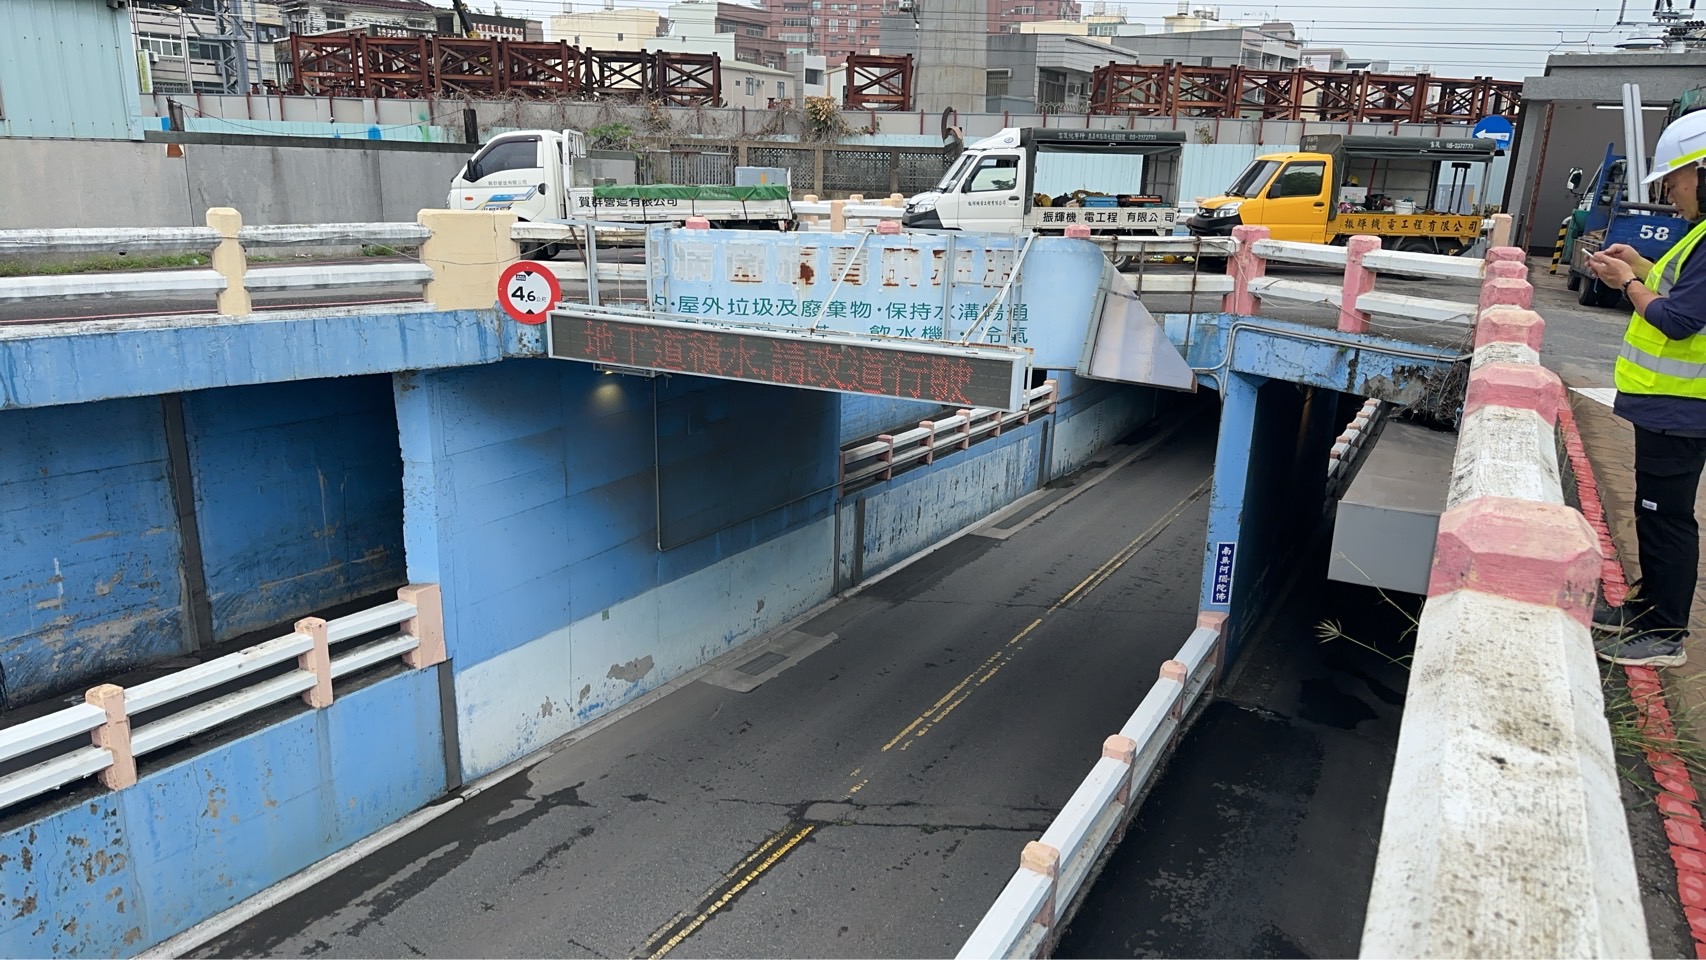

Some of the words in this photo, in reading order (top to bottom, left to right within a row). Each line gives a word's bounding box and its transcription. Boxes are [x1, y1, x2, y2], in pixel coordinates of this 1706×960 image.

[578, 196, 678, 208] 賀群營造有限公司
[1344, 218, 1479, 232] 振輝機電工程有限公司
[1639, 224, 1670, 241] 58
[511, 286, 536, 303] 4.6
[1215, 546, 1232, 602] 南無阿彌陀佛
